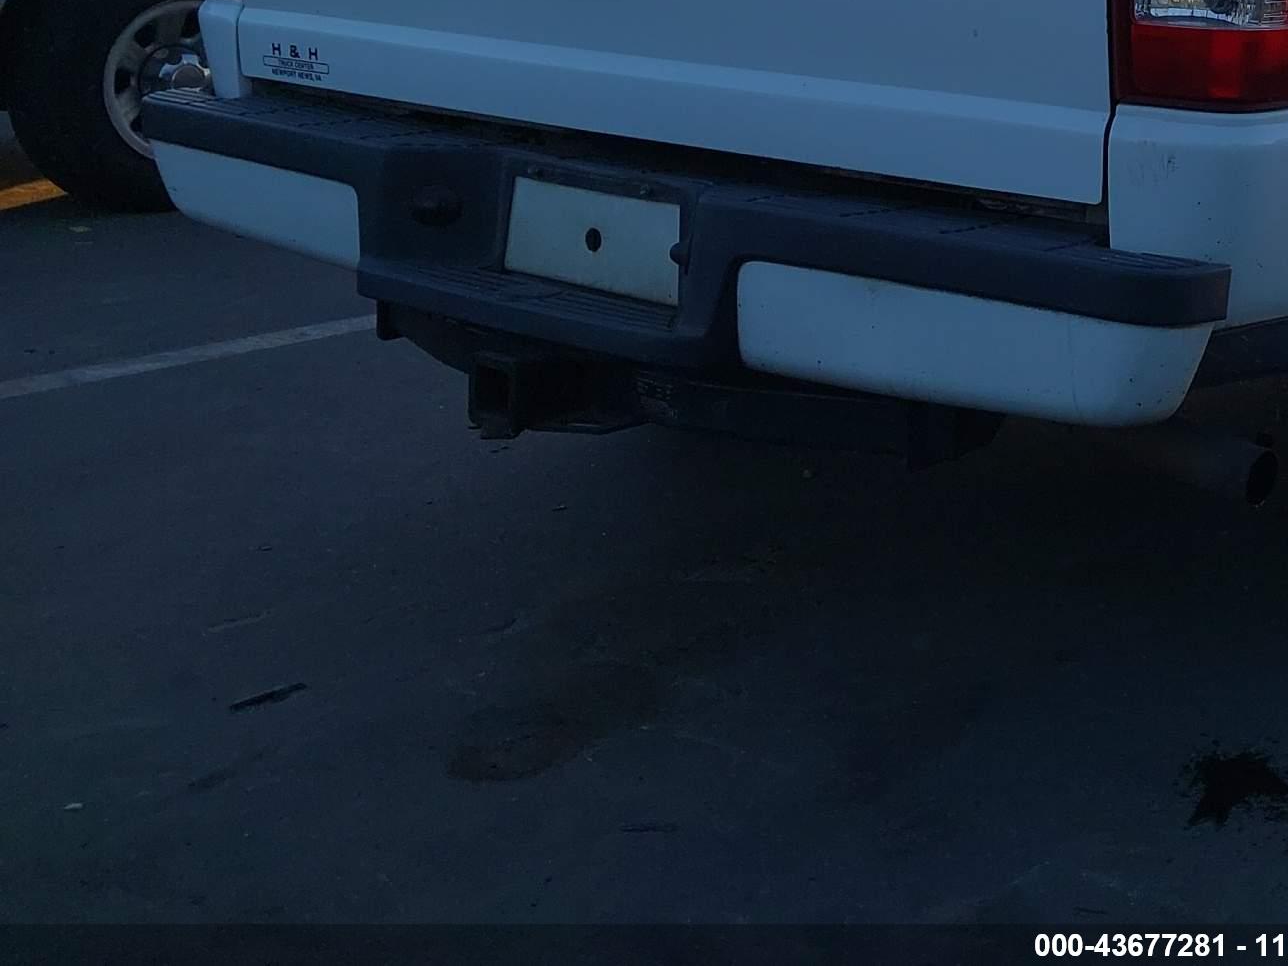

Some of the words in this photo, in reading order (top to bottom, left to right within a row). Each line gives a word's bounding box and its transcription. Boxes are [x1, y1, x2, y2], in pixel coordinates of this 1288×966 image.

[272, 43, 281, 56] H
[290, 45, 300, 58] &
[308, 47, 318, 60] H
